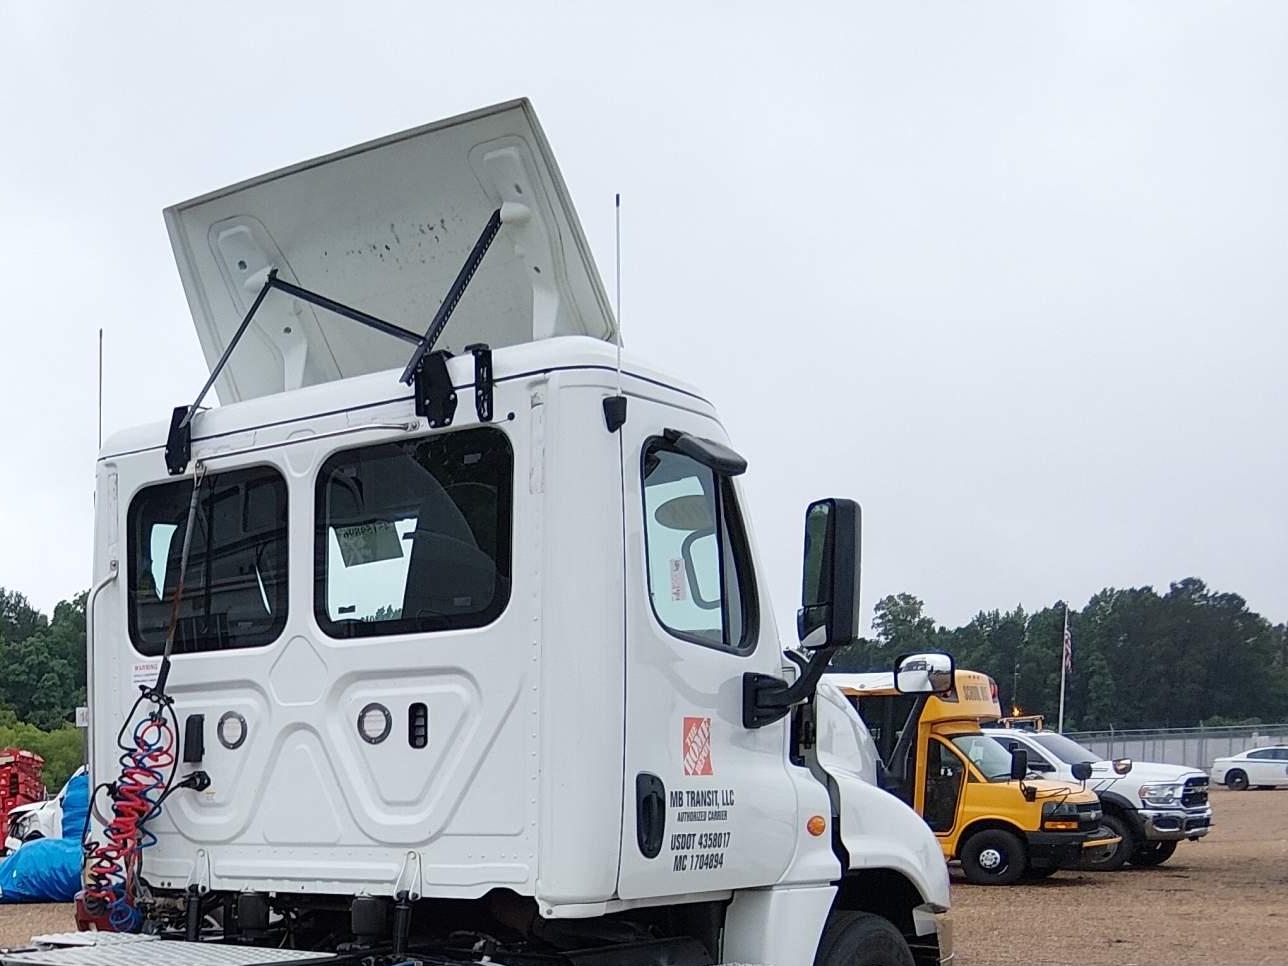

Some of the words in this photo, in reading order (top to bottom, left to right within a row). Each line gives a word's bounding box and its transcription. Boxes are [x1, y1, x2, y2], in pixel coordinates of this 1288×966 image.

[670, 790, 684, 808] MB
[686, 790, 720, 809] TRANSIT,
[721, 789, 735, 806] LLC
[677, 811, 707, 822] AUTHORIZED
[708, 810, 728, 821] CARRIER
[670, 833, 697, 851] USDOT
[698, 832, 731, 849] 4358017
[673, 854, 688, 872] MC
[690, 853, 724, 871] 1704894
